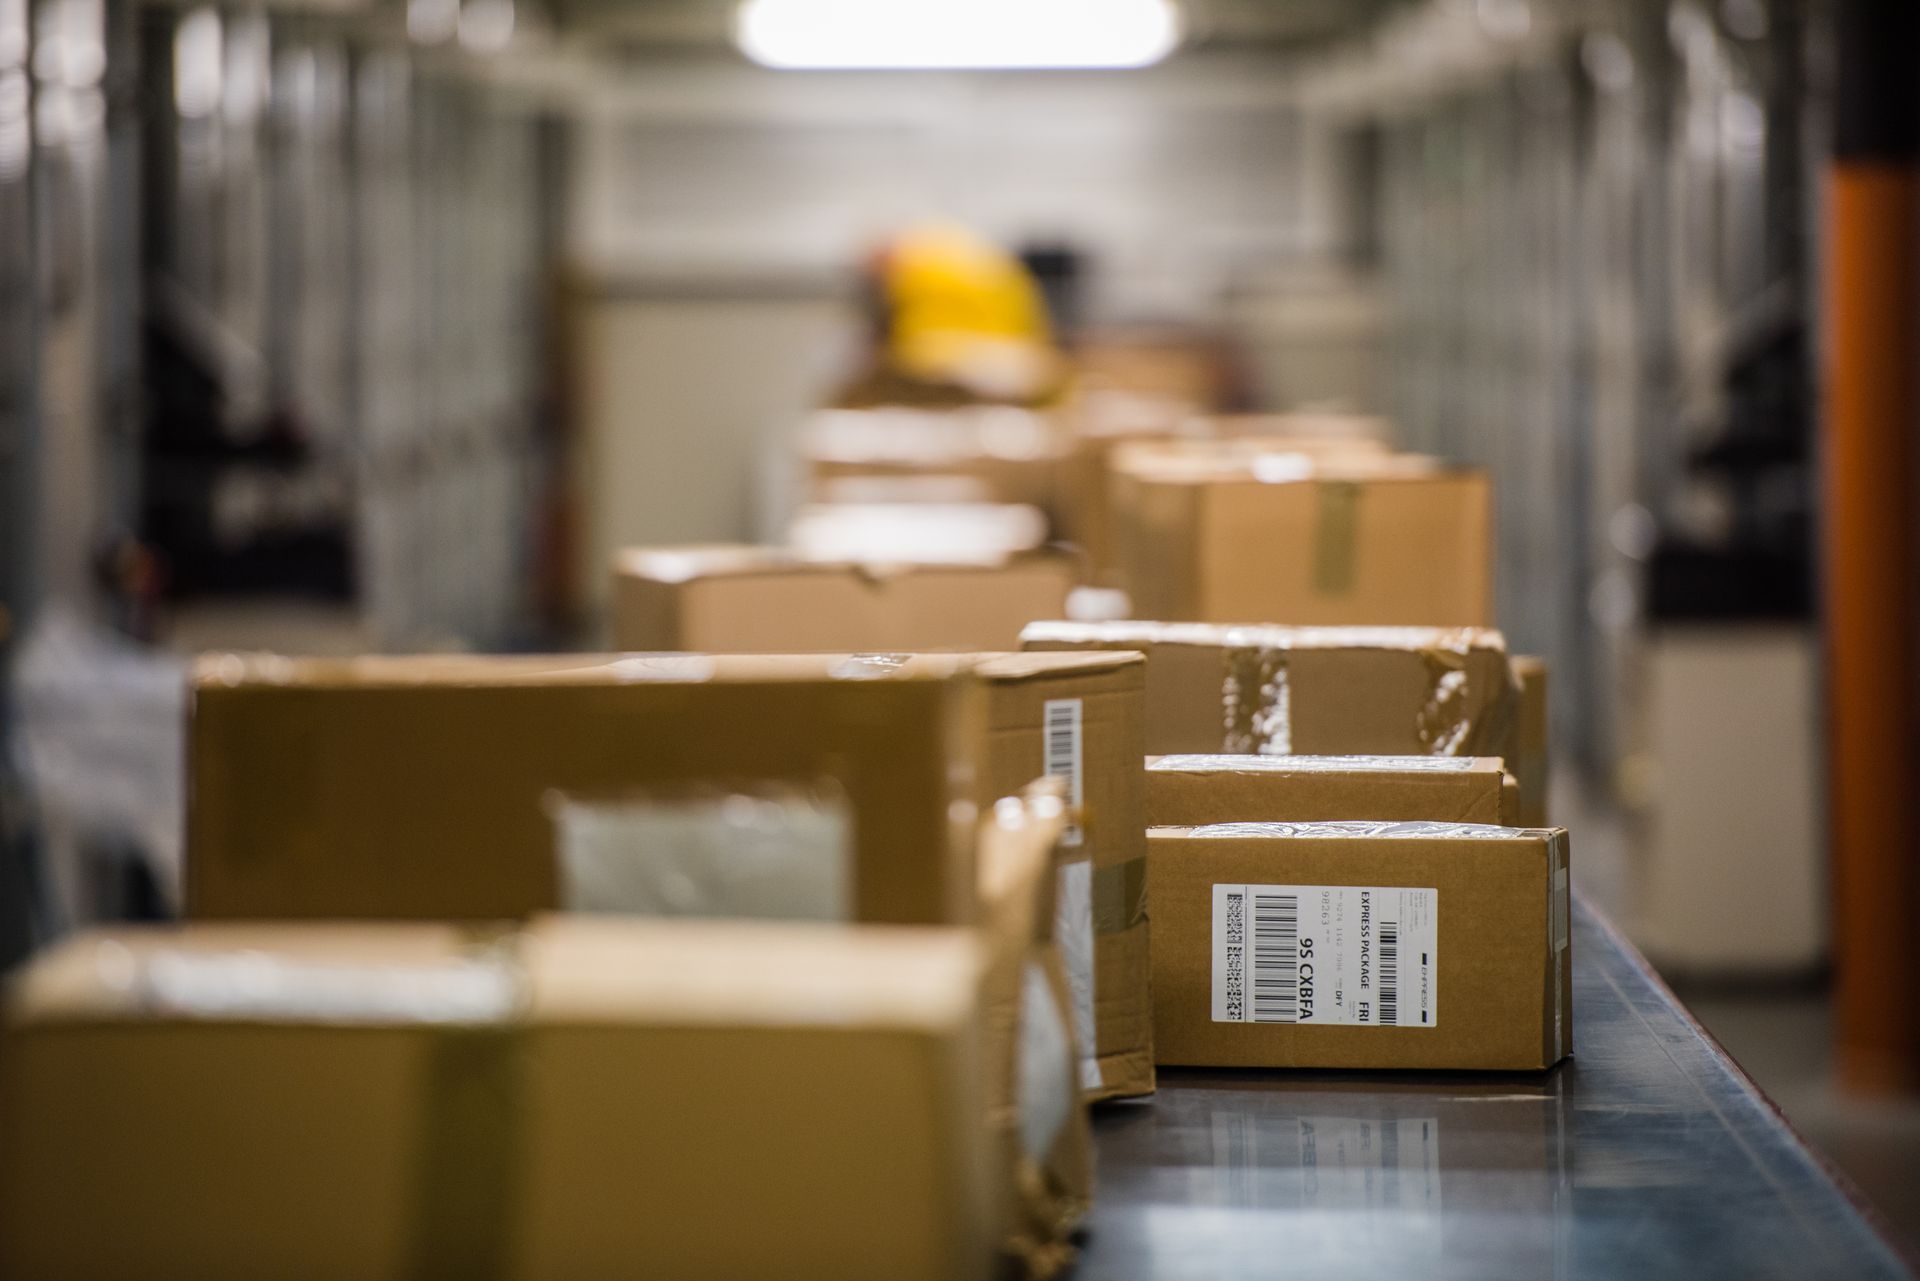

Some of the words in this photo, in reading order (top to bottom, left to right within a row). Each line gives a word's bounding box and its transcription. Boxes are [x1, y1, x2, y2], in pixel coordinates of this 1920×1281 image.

[1321, 891, 1330, 926] 98263
[1361, 891, 1370, 938] EXPRESS
[1299, 938, 1314, 959] 9S
[1361, 940, 1370, 989] PACKAGE
[1299, 963, 1314, 1020] CXBFA
[1335, 990, 1343, 1007] DFY
[1359, 1001, 1369, 1022] FRI
